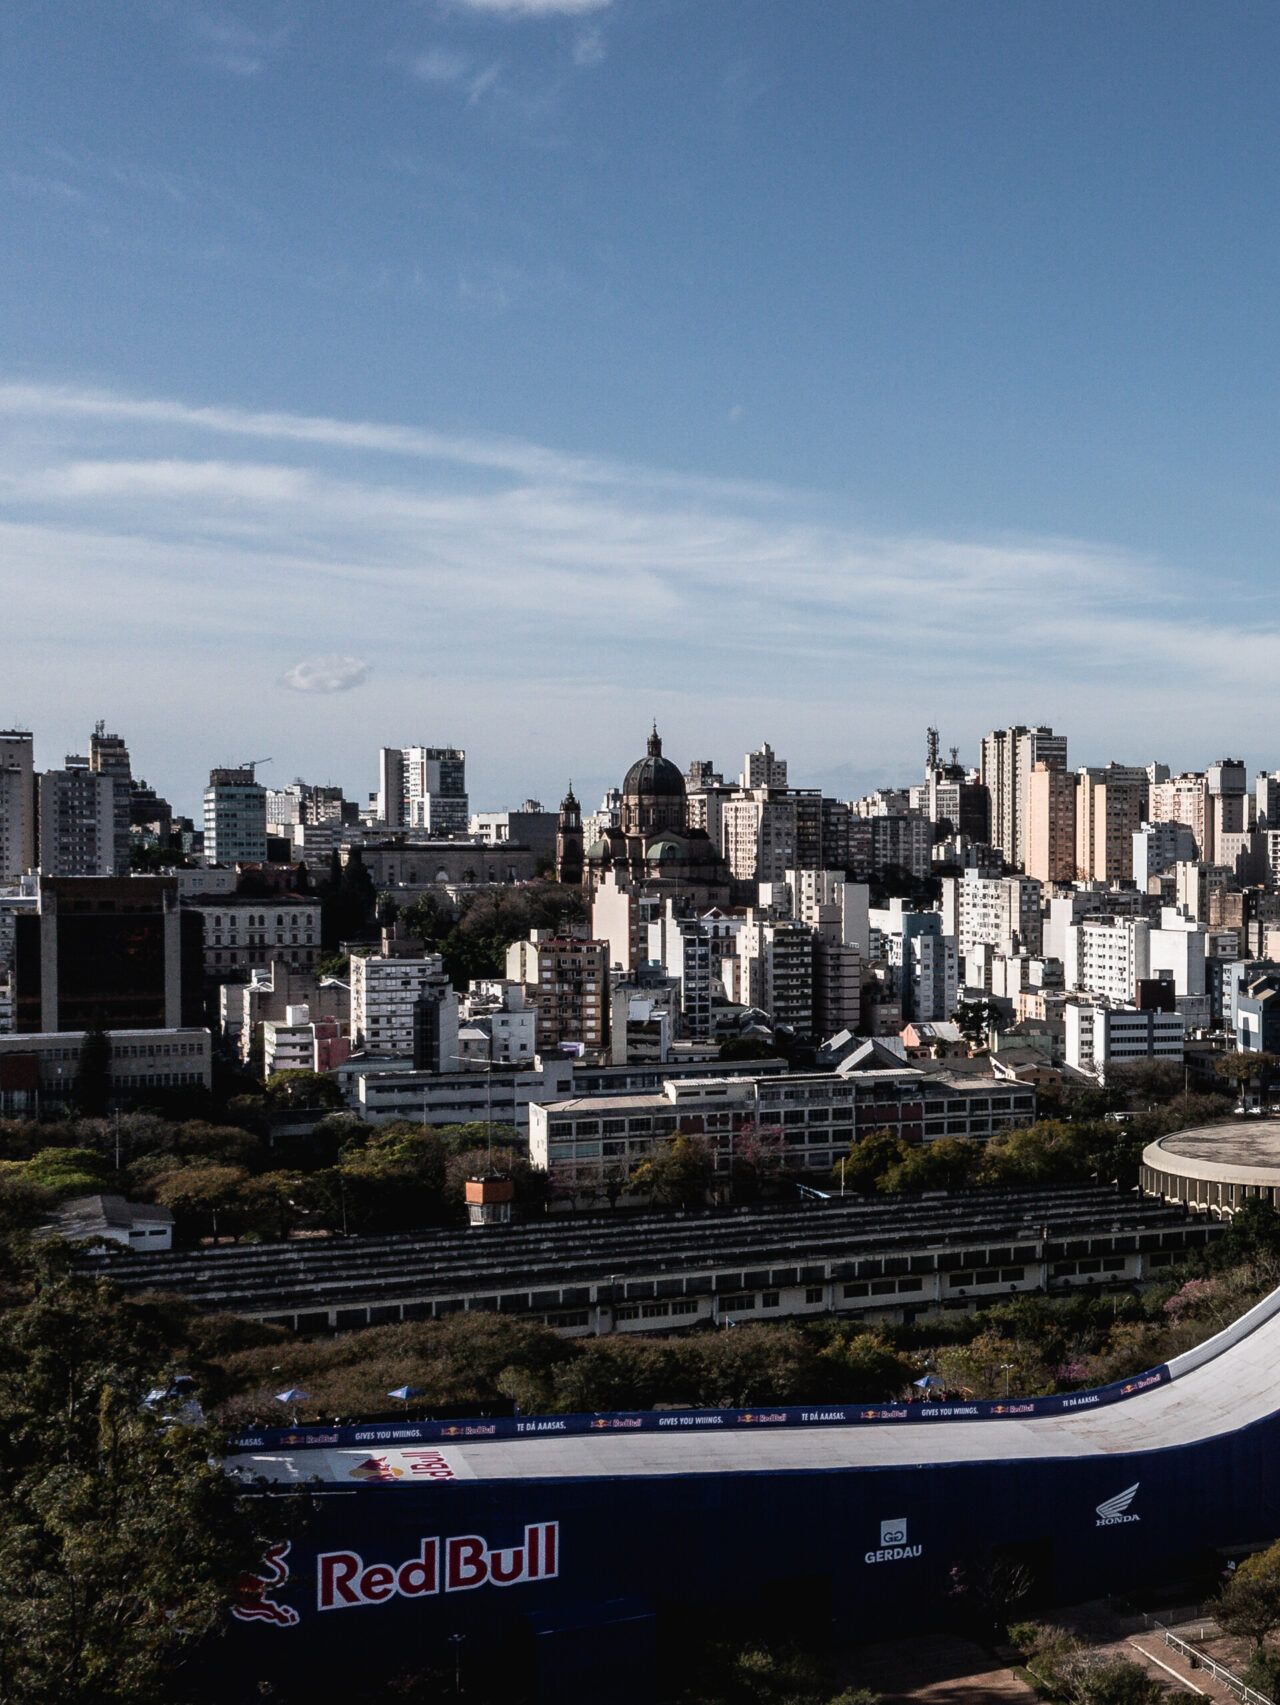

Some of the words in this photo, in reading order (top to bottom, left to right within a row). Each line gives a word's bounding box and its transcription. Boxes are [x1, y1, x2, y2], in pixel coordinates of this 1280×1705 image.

[801, 1413, 809, 1421] TE
[810, 1411, 819, 1420] DÁ
[922, 1408, 939, 1417] GIVES
[517, 1423, 525, 1431] TE
[526, 1421, 536, 1430] DÁ
[537, 1421, 566, 1430] AAASAS.
[659, 1417, 678, 1425] GIVES
[355, 1432, 375, 1440] GIVES
[376, 1431, 391, 1439] YOU
[1095, 1514, 1141, 1527] HONDA
[864, 1544, 922, 1564] GERDAU
[317, 1536, 440, 1611] Red
[445, 1521, 559, 1592] Bull
